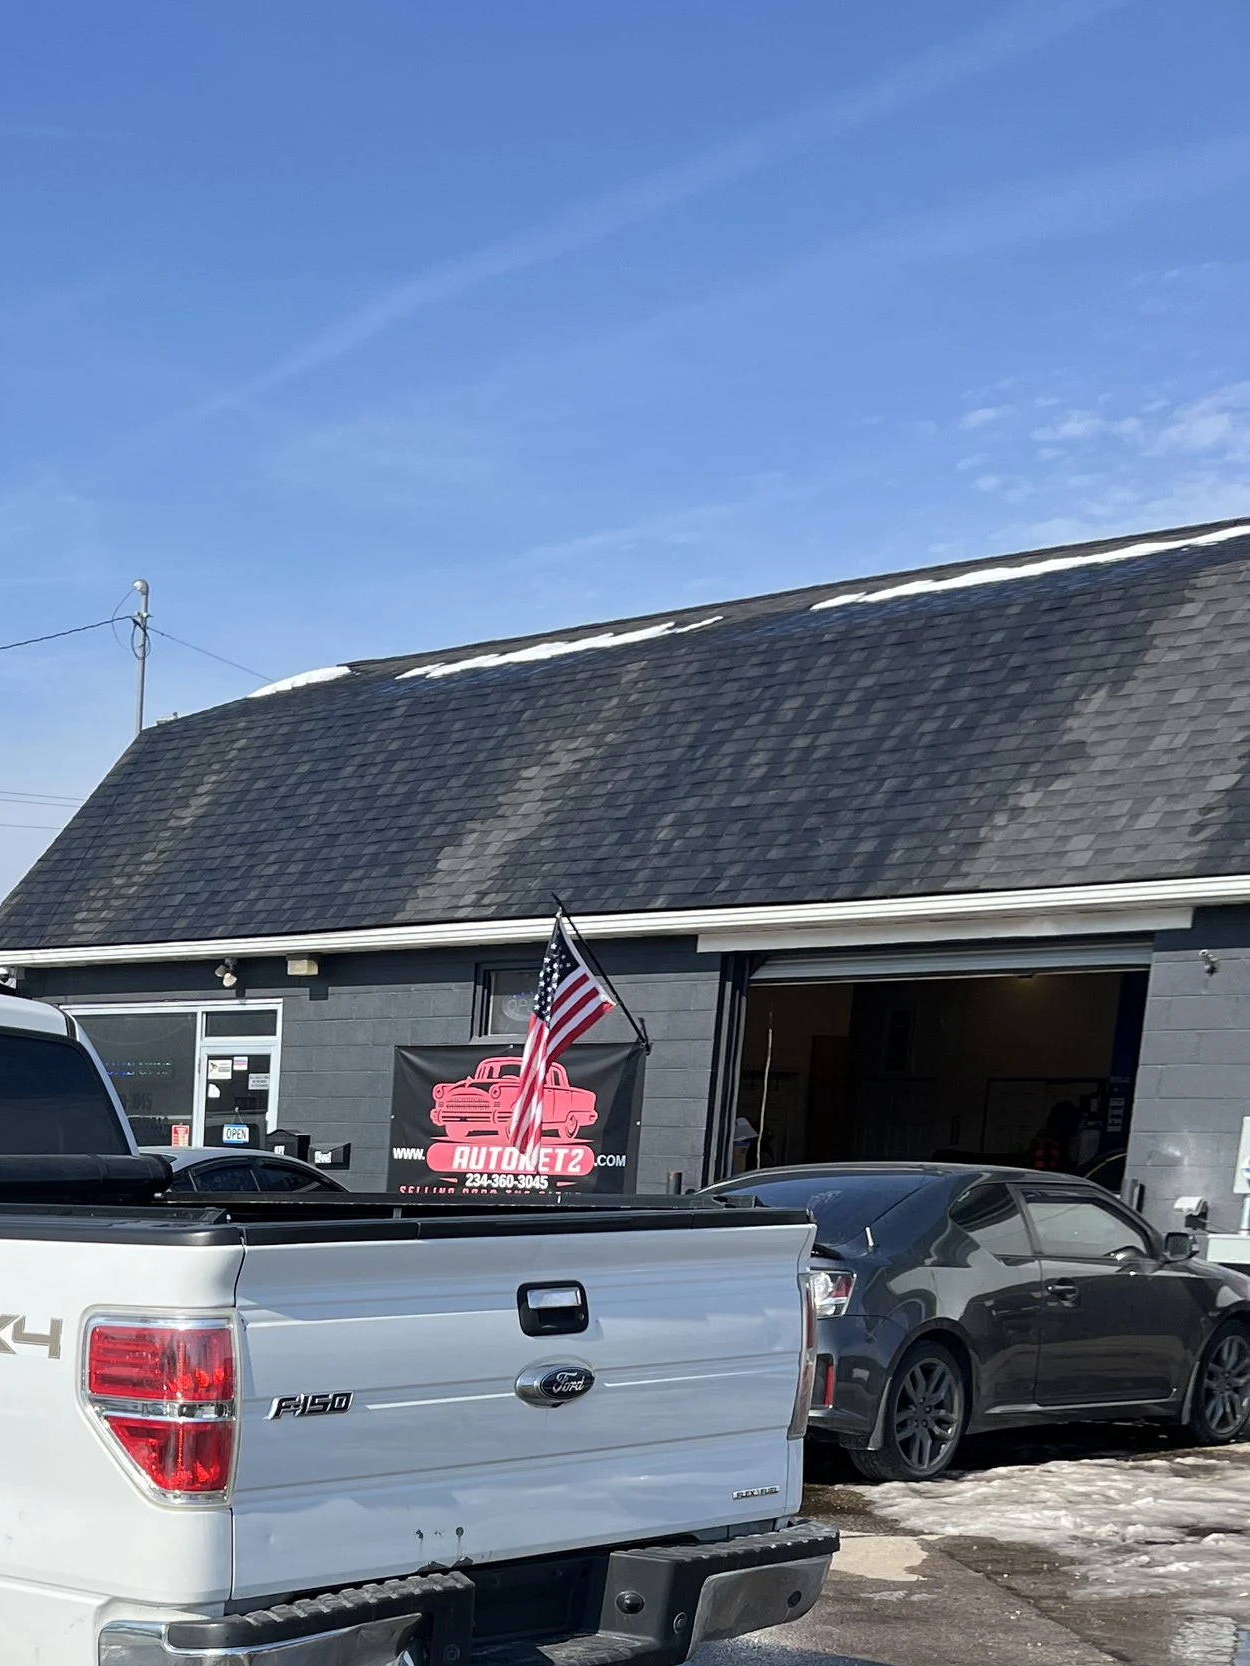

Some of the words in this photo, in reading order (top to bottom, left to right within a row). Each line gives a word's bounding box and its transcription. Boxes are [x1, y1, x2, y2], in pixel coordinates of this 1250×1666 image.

[226, 1127, 247, 1140] OPEN
[465, 1173, 549, 1189] 234-360-3045
[552, 1371, 586, 1394] Ford
